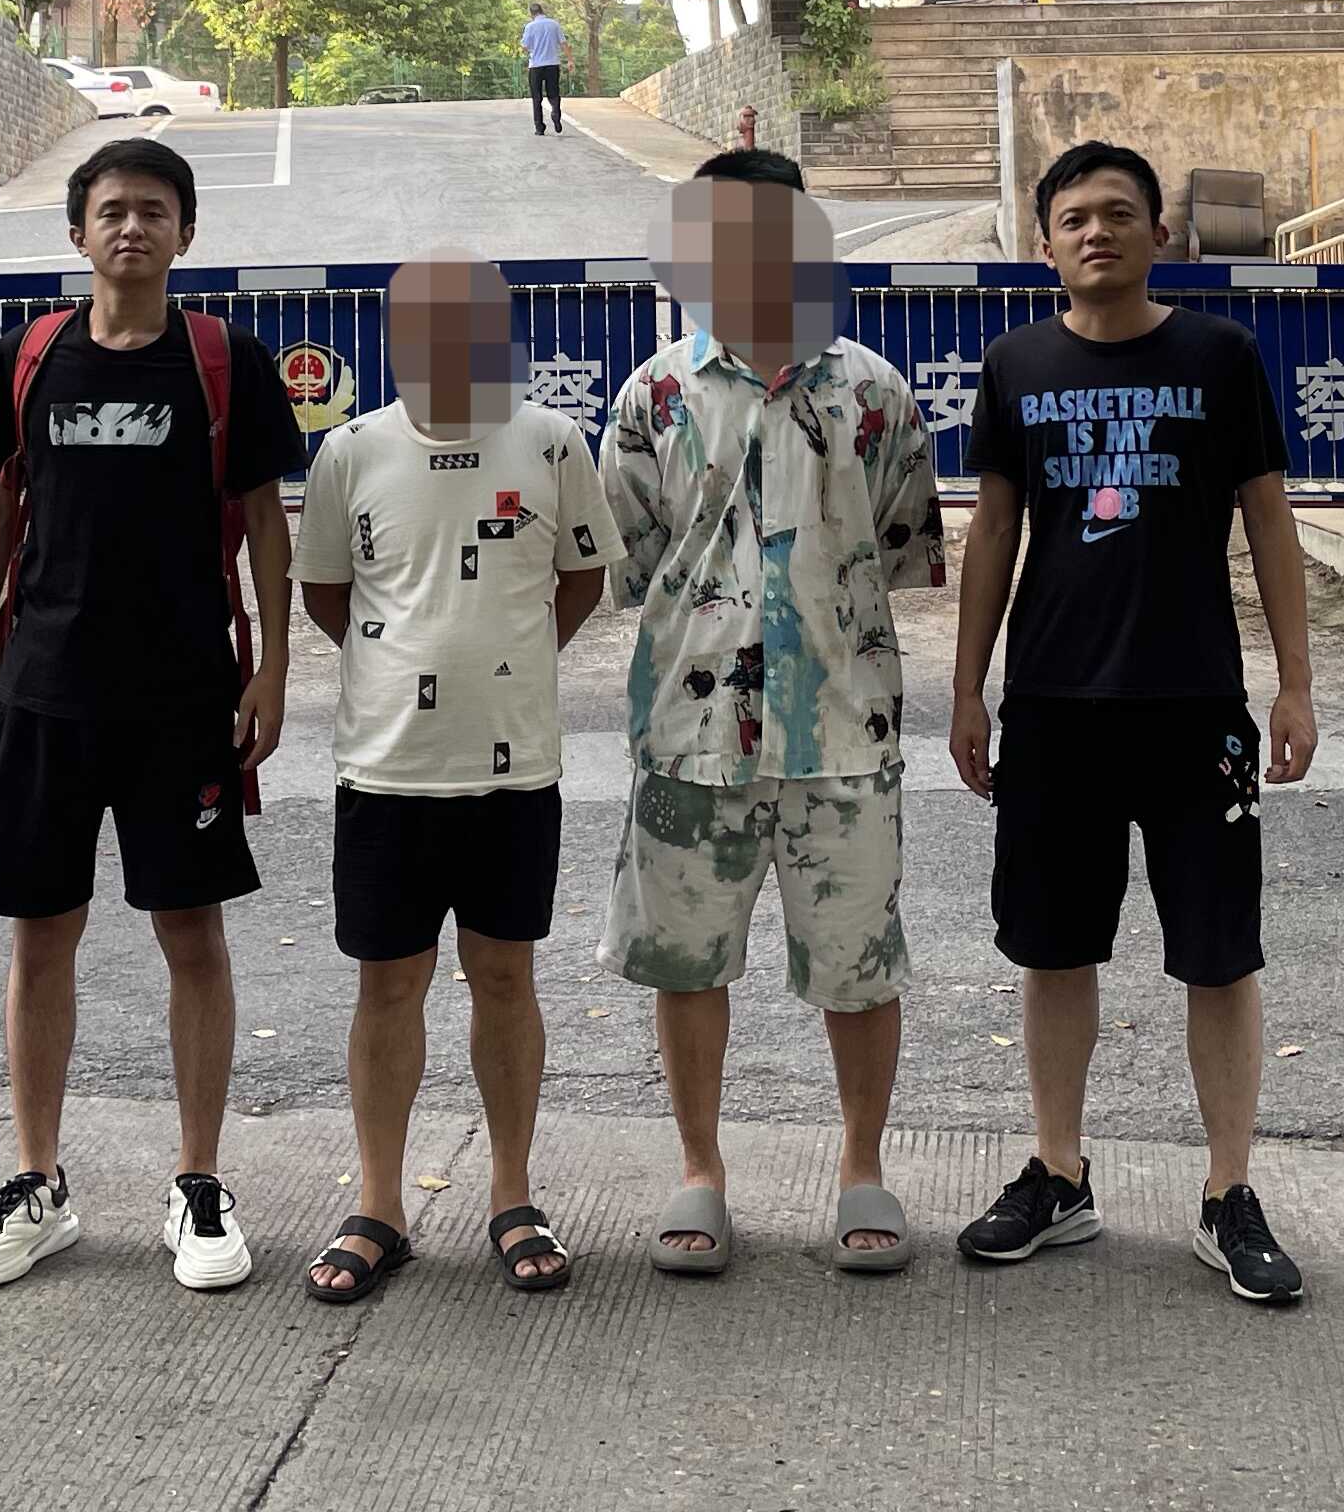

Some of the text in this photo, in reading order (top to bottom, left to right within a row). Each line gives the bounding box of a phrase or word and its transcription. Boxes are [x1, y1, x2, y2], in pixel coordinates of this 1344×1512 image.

[914, 351, 984, 433] 安
[1021, 386, 1206, 427] BASKETBALL
[1067, 419, 1157, 454] IS MY
[1044, 453, 1181, 488] SUMMER
